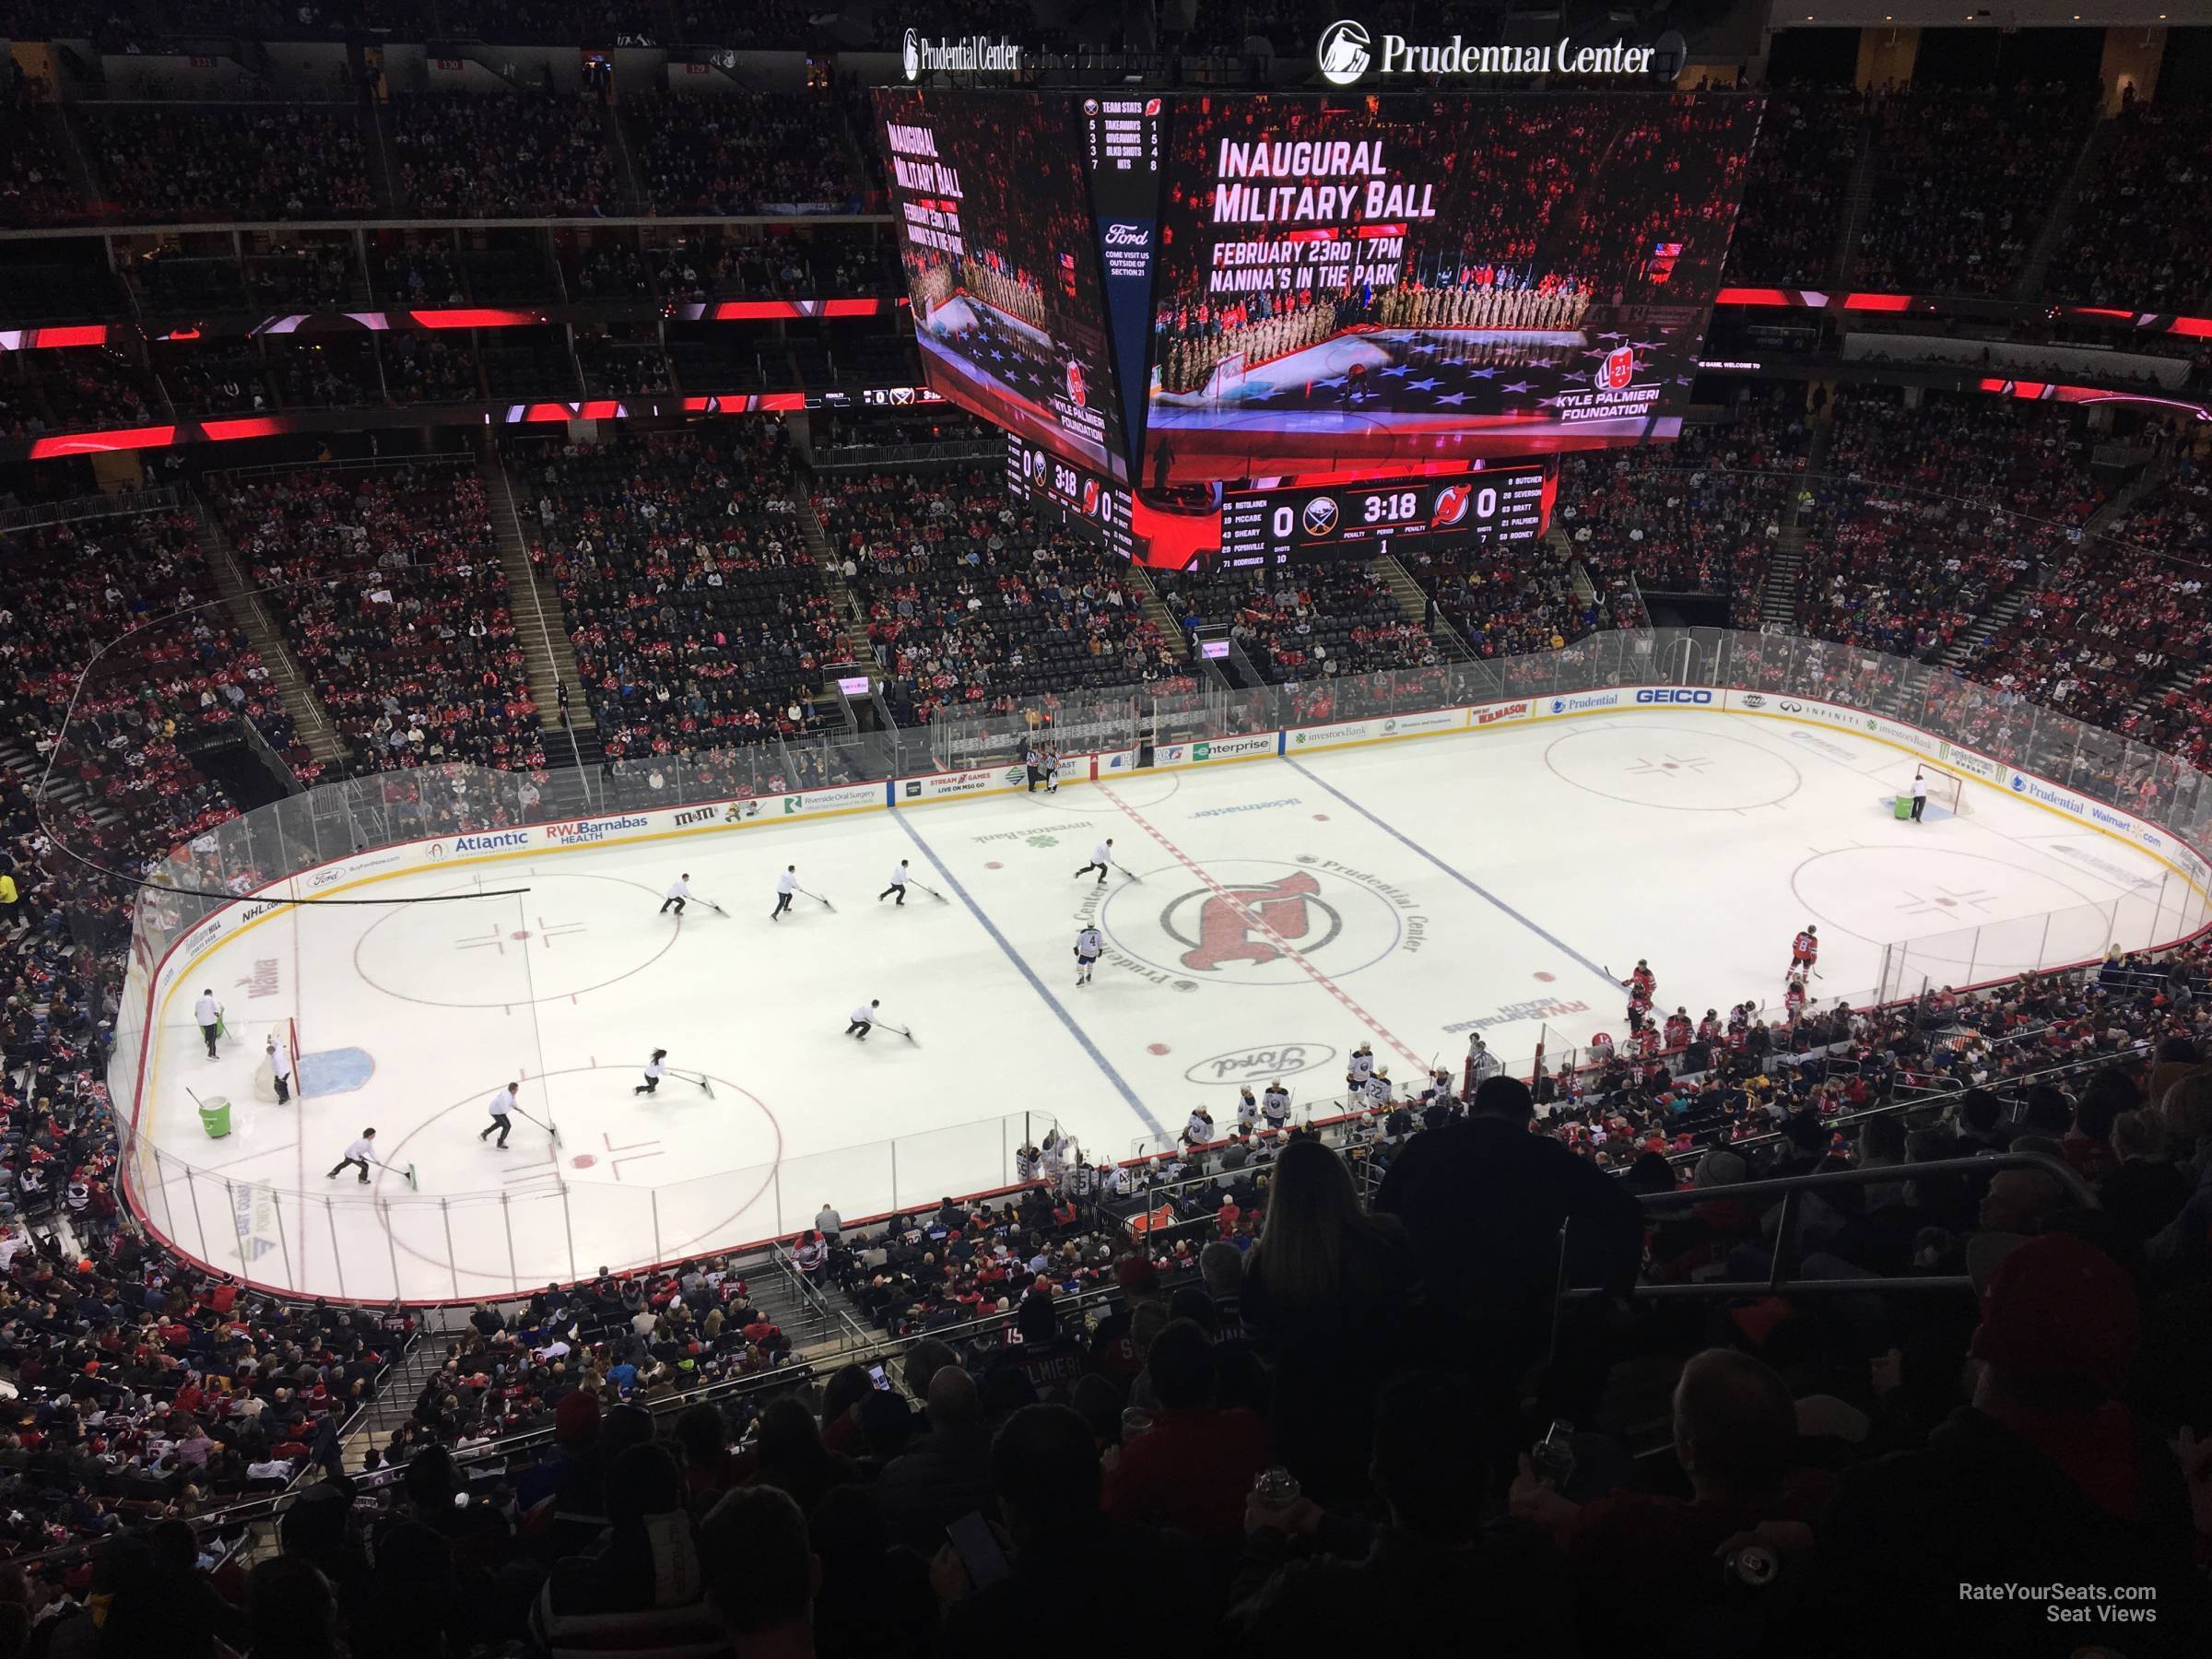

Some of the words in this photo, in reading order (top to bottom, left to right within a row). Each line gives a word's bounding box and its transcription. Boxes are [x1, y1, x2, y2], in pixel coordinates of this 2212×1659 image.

[921, 37, 977, 70] Prudential
[979, 36, 1018, 70] Center
[1383, 34, 1550, 73] Prudential
[1557, 37, 1656, 73] Center
[1102, 102, 1122, 113] TEAM
[1123, 102, 1142, 113] STATS
[1089, 120, 1095, 129] 5
[1105, 121, 1141, 130] TAKEAWAYS
[1151, 121, 1157, 130] 1
[887, 121, 938, 158] INAUGURAL
[1090, 134, 1096, 143] 3
[1106, 134, 1141, 143] GIVEAWAYS
[1152, 135, 1158, 144] 5
[1091, 146, 1096, 156] 3
[1123, 147, 1142, 156] SHOTS
[1151, 147, 1158, 156] 4
[1218, 137, 1387, 178] INAUGURAL
[1092, 160, 1098, 169] 7
[1117, 159, 1131, 169] HITS
[1150, 161, 1157, 171] 8
[893, 155, 936, 193] MILITARY
[935, 162, 964, 199] BALL
[1213, 182, 1359, 223] MILITARY
[1365, 180, 1436, 218] BALL
[1105, 224, 1149, 245] Ford
[1213, 241, 1305, 265] FEBRUARY
[1308, 239, 1352, 262] 23RD
[1367, 237, 1403, 260] 7PM
[1209, 268, 1292, 292] NANINA'S
[1295, 267, 1313, 288] IN
[1318, 266, 1350, 288] THE
[1352, 264, 1399, 286] PARK
[1615, 365, 1626, 377] 21
[1556, 393, 1592, 407] KYLE
[1596, 389, 1659, 405] PALMIERI
[1055, 399, 1073, 415] KYLE
[1562, 403, 1649, 420] FOUNDATION
[1061, 415, 1104, 442] FOUNDATION
[1024, 450, 1031, 478] 0
[1055, 465, 1077, 497] 3:18
[1515, 476, 1543, 484] BUTCHER
[1514, 489, 1542, 498] SEVERSON
[1102, 492, 1111, 522] 0
[1235, 500, 1267, 510] RISTOLAINEN
[1364, 493, 1417, 522] 3:18
[1477, 488, 1497, 518] 0
[1513, 504, 1532, 512] BRATT
[1063, 510, 1066, 523] 1
[1235, 514, 1262, 524] MCCABE
[1273, 507, 1294, 537] 0
[1512, 517, 1539, 525] PALMIERI
[1235, 529, 1260, 538] SHEARY
[1510, 531, 1533, 540] ROONEY
[1381, 540, 1387, 553] 1
[1234, 556, 1264, 566] RODRIGUES
[1277, 555, 1287, 564] 10
[1569, 694, 1618, 710] Prudential
[1636, 690, 1712, 704] GEICO
[1806, 707, 1859, 725] INFINITI
[1308, 725, 1367, 742] investorsBank
[1879, 722, 1933, 750] investorsBank
[1198, 739, 1269, 757] enterprise
[930, 776, 957, 787] STREAM
[968, 772, 991, 782] GAMES
[805, 795, 835, 805] Riverside
[835, 792, 848, 801] Oral
[849, 790, 876, 800] Surgery
[2029, 782, 2084, 815] Prudential
[546, 817, 648, 839] RWJBarnabas
[971, 820, 1095, 844] investorsBank
[2092, 807, 2131, 832] Walmart
[2143, 832, 2161, 848] com
[456, 830, 529, 852] Atlantic
[561, 830, 603, 844] HEALTH
[349, 855, 400, 872] BuyFordNow.com
[313, 871, 339, 887] Ford
[1073, 882, 1110, 921] Center
[1321, 860, 1420, 909] Prudential
[1402, 915, 1429, 953] Center
[208, 921, 221, 935] HILL
[1090, 935, 1096, 946] 4
[1799, 941, 1807, 952] 8
[248, 959, 279, 999] Wawa
[1497, 997, 1560, 1014] HEALTH
[1211, 1047, 1306, 1078] Ford
